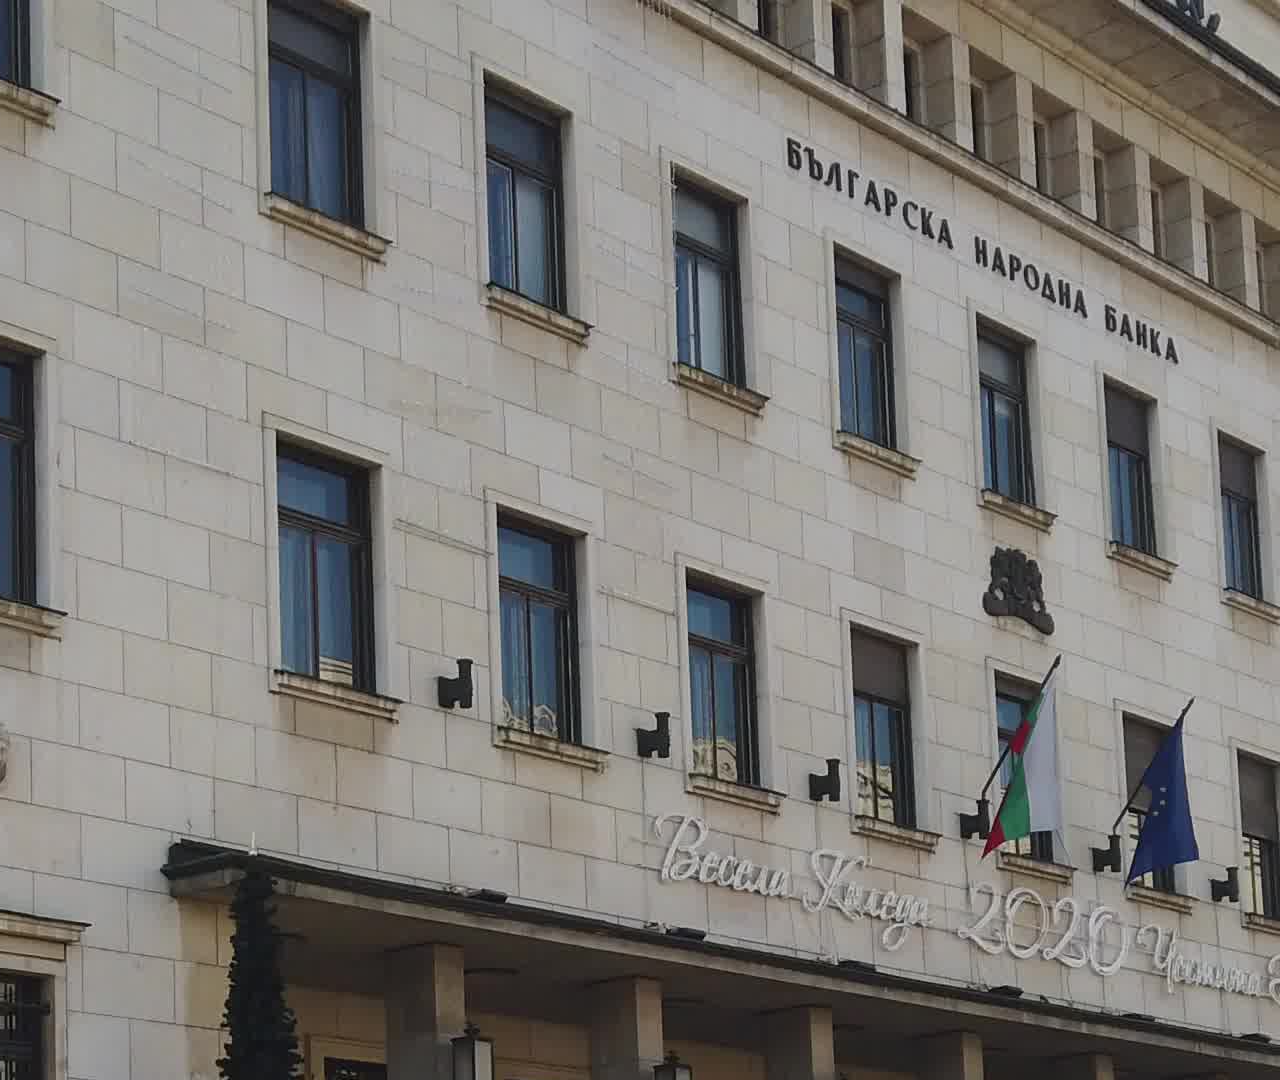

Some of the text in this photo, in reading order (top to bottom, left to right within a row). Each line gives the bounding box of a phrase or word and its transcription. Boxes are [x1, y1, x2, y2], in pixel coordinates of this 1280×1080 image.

[785, 136, 1180, 365] БЪЛГАРСКА НАРОДНА БАНКА
[655, 814, 795, 897] Весела
[958, 882, 1131, 976] 2020
